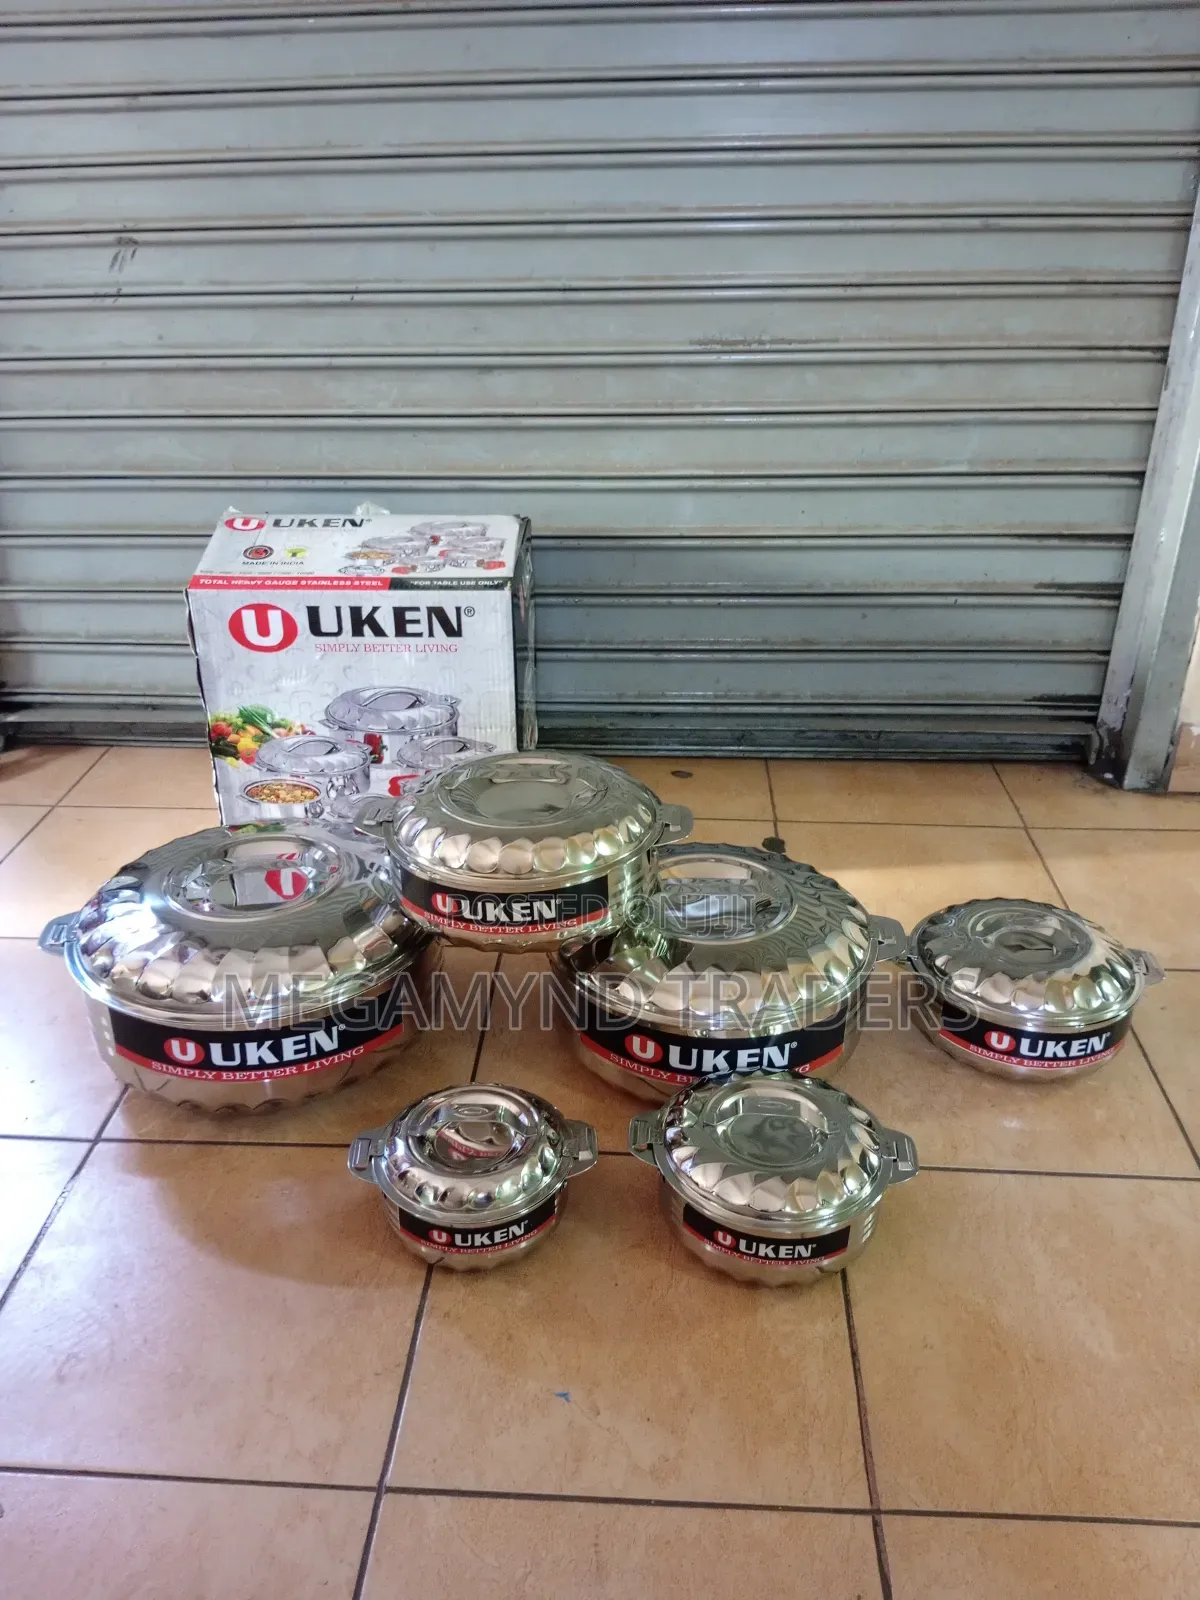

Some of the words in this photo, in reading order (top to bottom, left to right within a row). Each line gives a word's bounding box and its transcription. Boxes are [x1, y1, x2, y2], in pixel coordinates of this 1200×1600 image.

[314, 643, 360, 653] SIMPLY
[364, 643, 412, 653] BETTER
[415, 643, 458, 653] LIVING
[423, 911, 466, 929] SIMPLY
[469, 925, 524, 934] BETTER
[528, 918, 577, 933] LIVING
[151, 1060, 216, 1080] SIMPLY
[221, 1066, 298, 1081] BETTER
[302, 1046, 365, 1072] LIVING
[609, 1053, 671, 1080] SIMPLY
[969, 1043, 1020, 1065] SIMPLY
[1023, 1059, 1076, 1068] BETTER
[504, 1230, 538, 1248] LIVING
